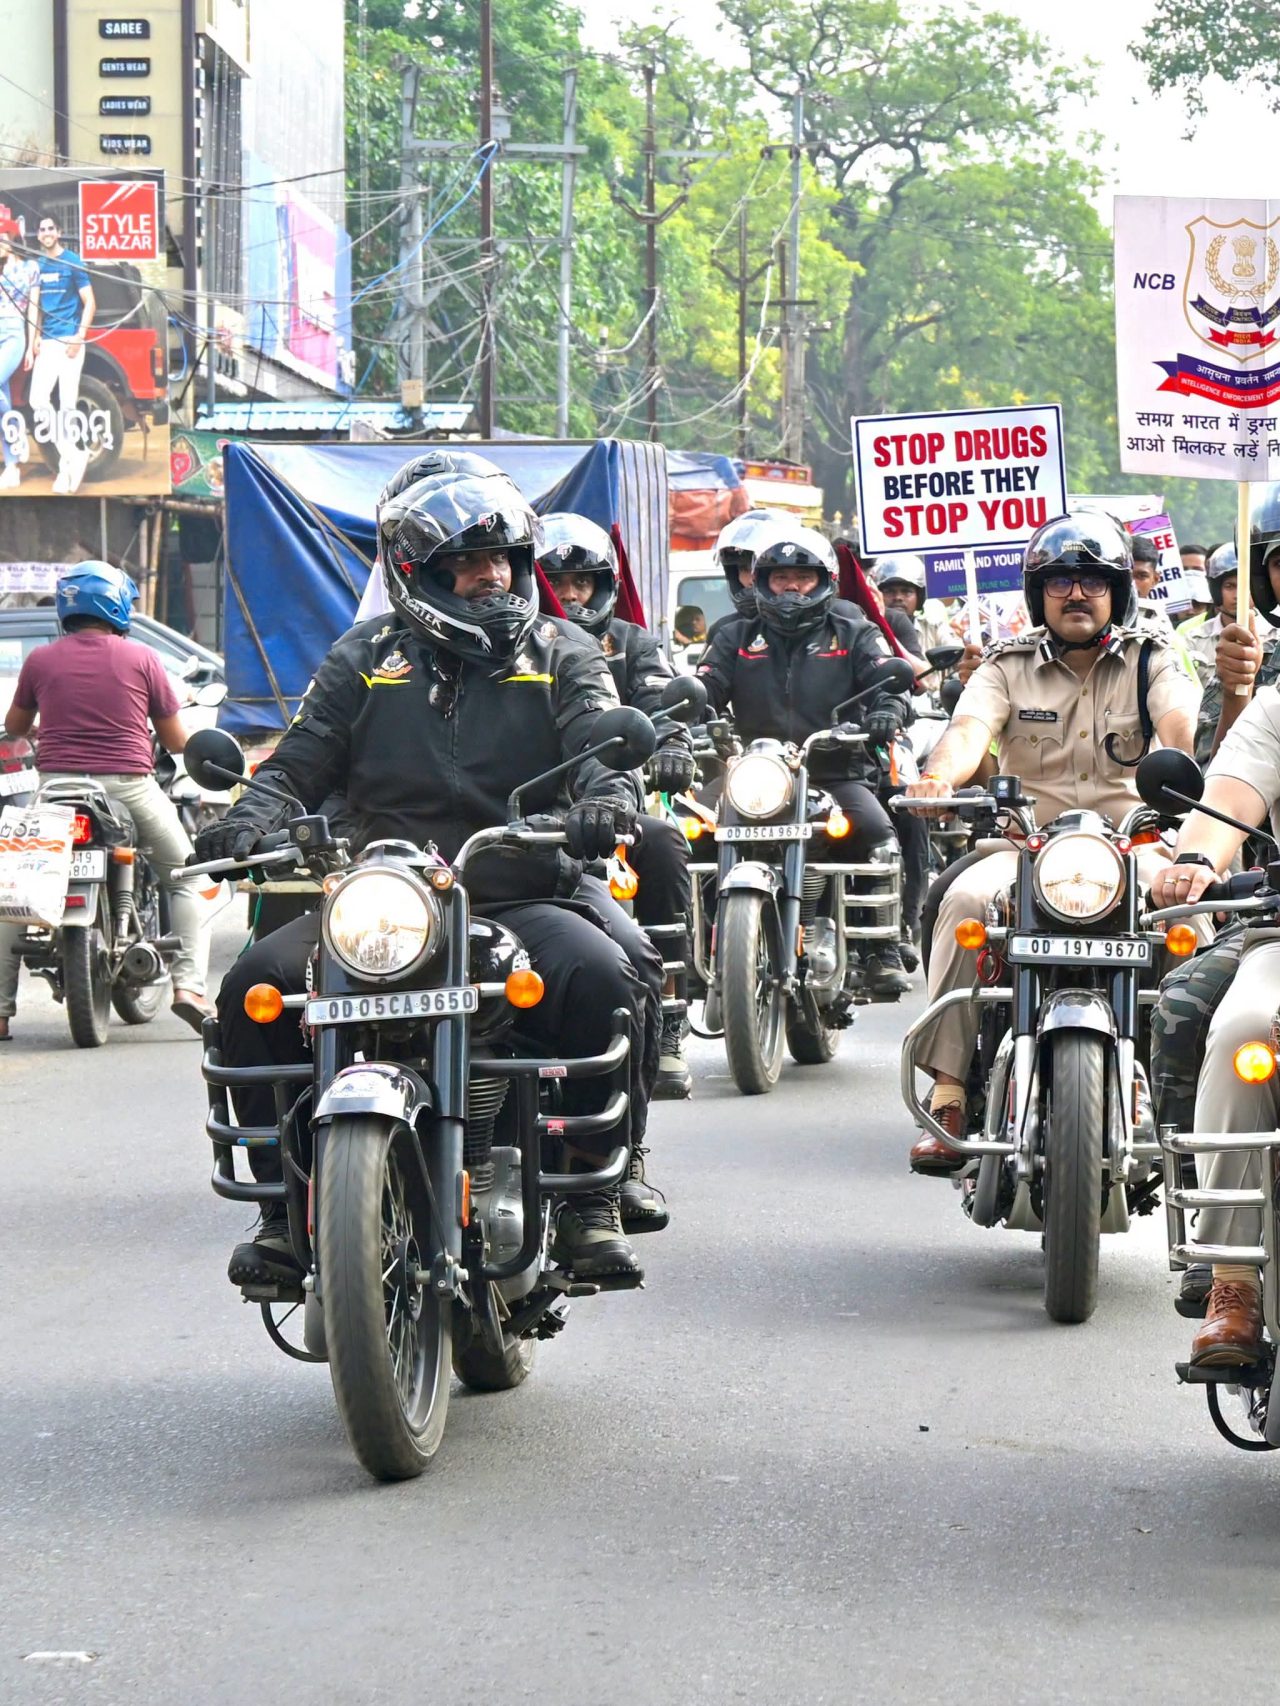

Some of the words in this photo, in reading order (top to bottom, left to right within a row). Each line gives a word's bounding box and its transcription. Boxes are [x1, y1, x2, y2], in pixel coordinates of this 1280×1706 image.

[105, 22, 143, 35] SAREE
[102, 62, 125, 72] GENTS
[126, 62, 147, 72] WEAR
[102, 101, 126, 109] LADIES
[127, 100, 147, 109] WEAR
[102, 139, 122, 148] KIDS
[123, 139, 148, 148] WEAR
[86, 214, 152, 235] STYLE
[85, 233, 153, 251] BAAZAR
[1133, 272, 1176, 290] NCB
[1196, 364, 1231, 383] आसूचना
[1234, 373, 1259, 385] प्रवर्तन
[1180, 377, 1221, 397] INTELLIGENCE
[1222, 391, 1264, 402] ENFORCEMENT
[1136, 411, 1173, 429] समग्र
[1182, 412, 1221, 431] भारत
[1229, 413, 1241, 431] में
[1246, 415, 1277, 436] ड्रग्स
[873, 431, 945, 468] STOP
[955, 424, 1047, 462] DRUGS
[1127, 434, 1164, 453] आओ
[1172, 435, 1226, 457] मिलकर
[1234, 439, 1259, 462] लड़ें
[883, 470, 975, 501] BEFORE
[981, 466, 1040, 494] THEY
[883, 502, 968, 538] STOP
[977, 497, 1047, 531] YOU
[1153, 533, 1175, 551] EE
[933, 558, 966, 573] FAMILY
[975, 556, 992, 569] ND
[993, 553, 1021, 567] YOUR
[1148, 586, 1169, 601] ON
[1064, 940, 1093, 956] 19Y
[1105, 942, 1146, 958] 9670
